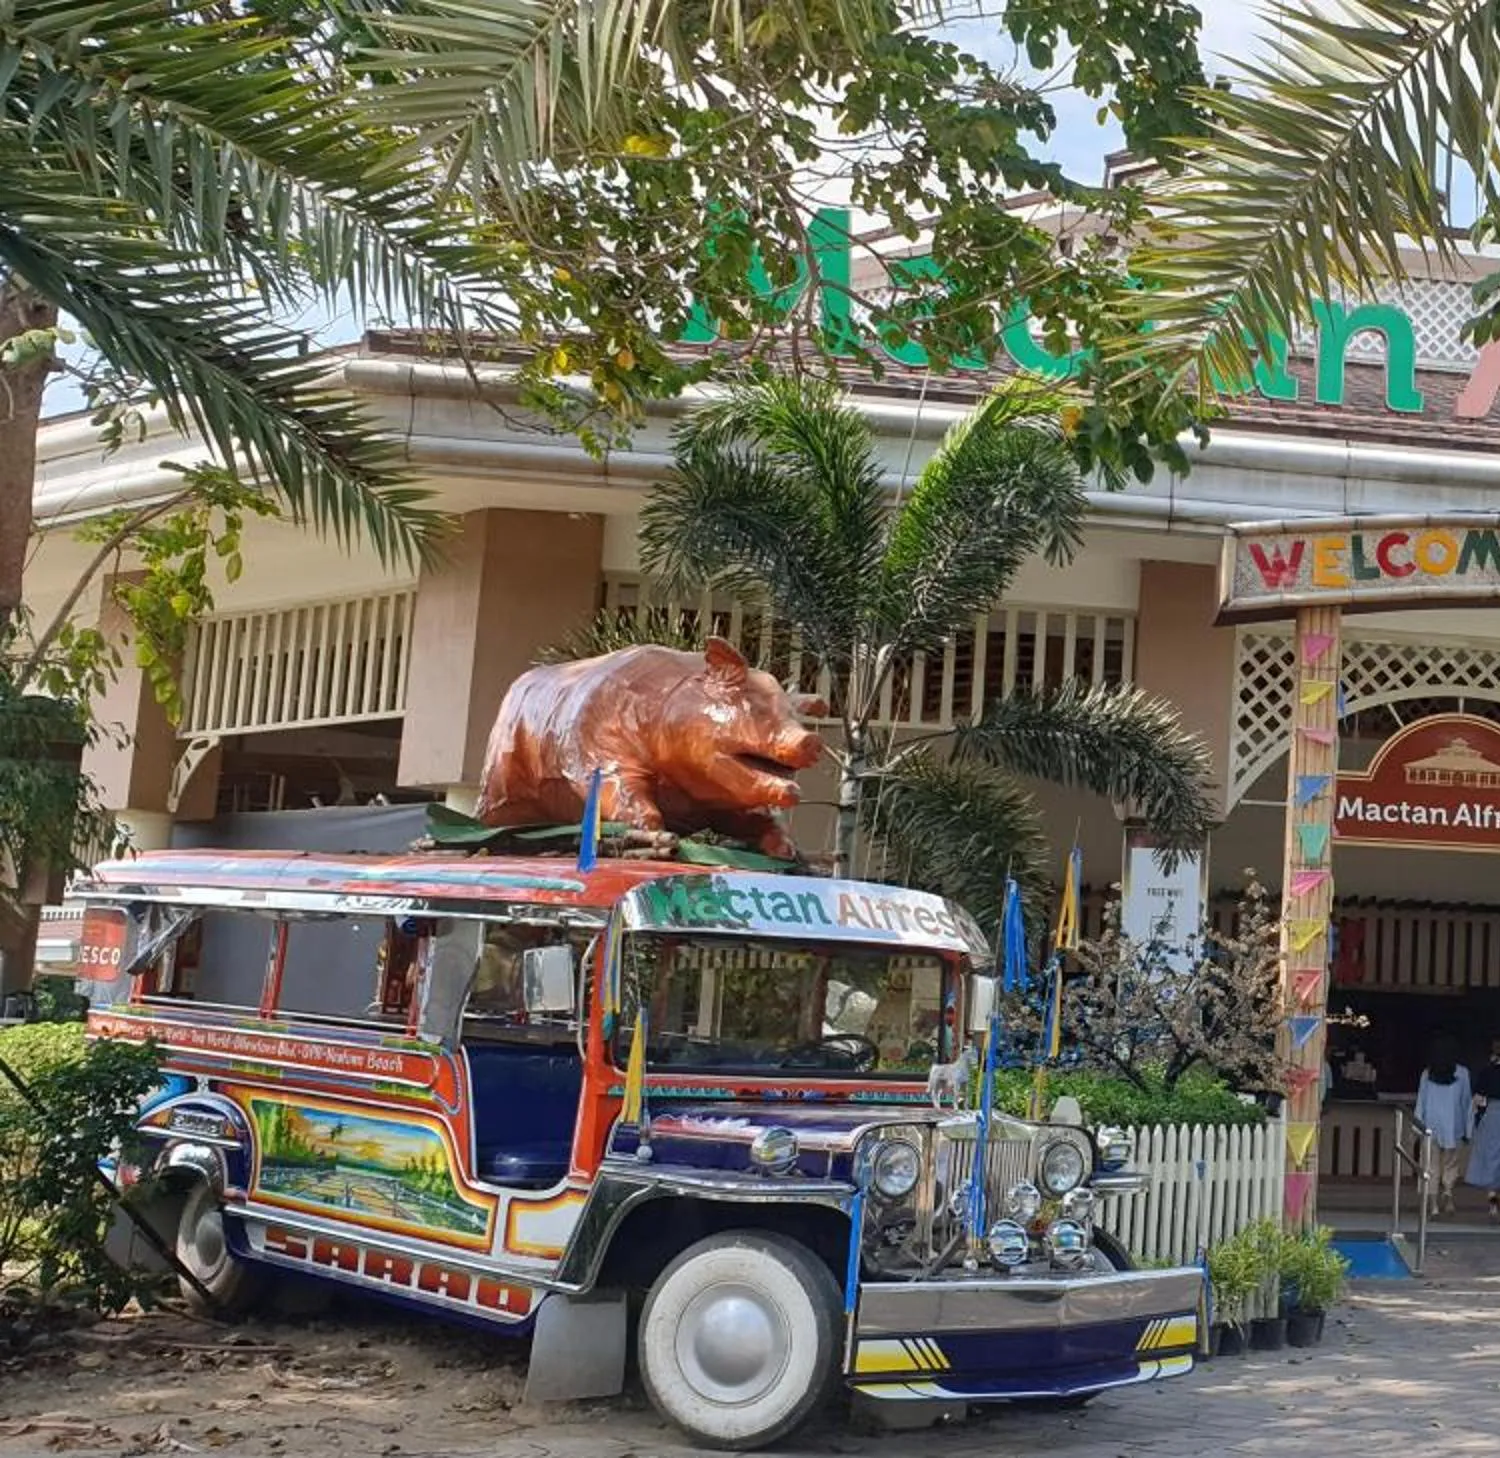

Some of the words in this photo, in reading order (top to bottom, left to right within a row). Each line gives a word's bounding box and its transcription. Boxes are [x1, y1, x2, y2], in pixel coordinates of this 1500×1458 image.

[678, 199, 1424, 414] Macan
[1336, 796, 1449, 826] Mactan
[649, 881, 832, 928] Mactan
[367, 1051, 404, 1072] Beach
[263, 1225, 533, 1315] SARAO
